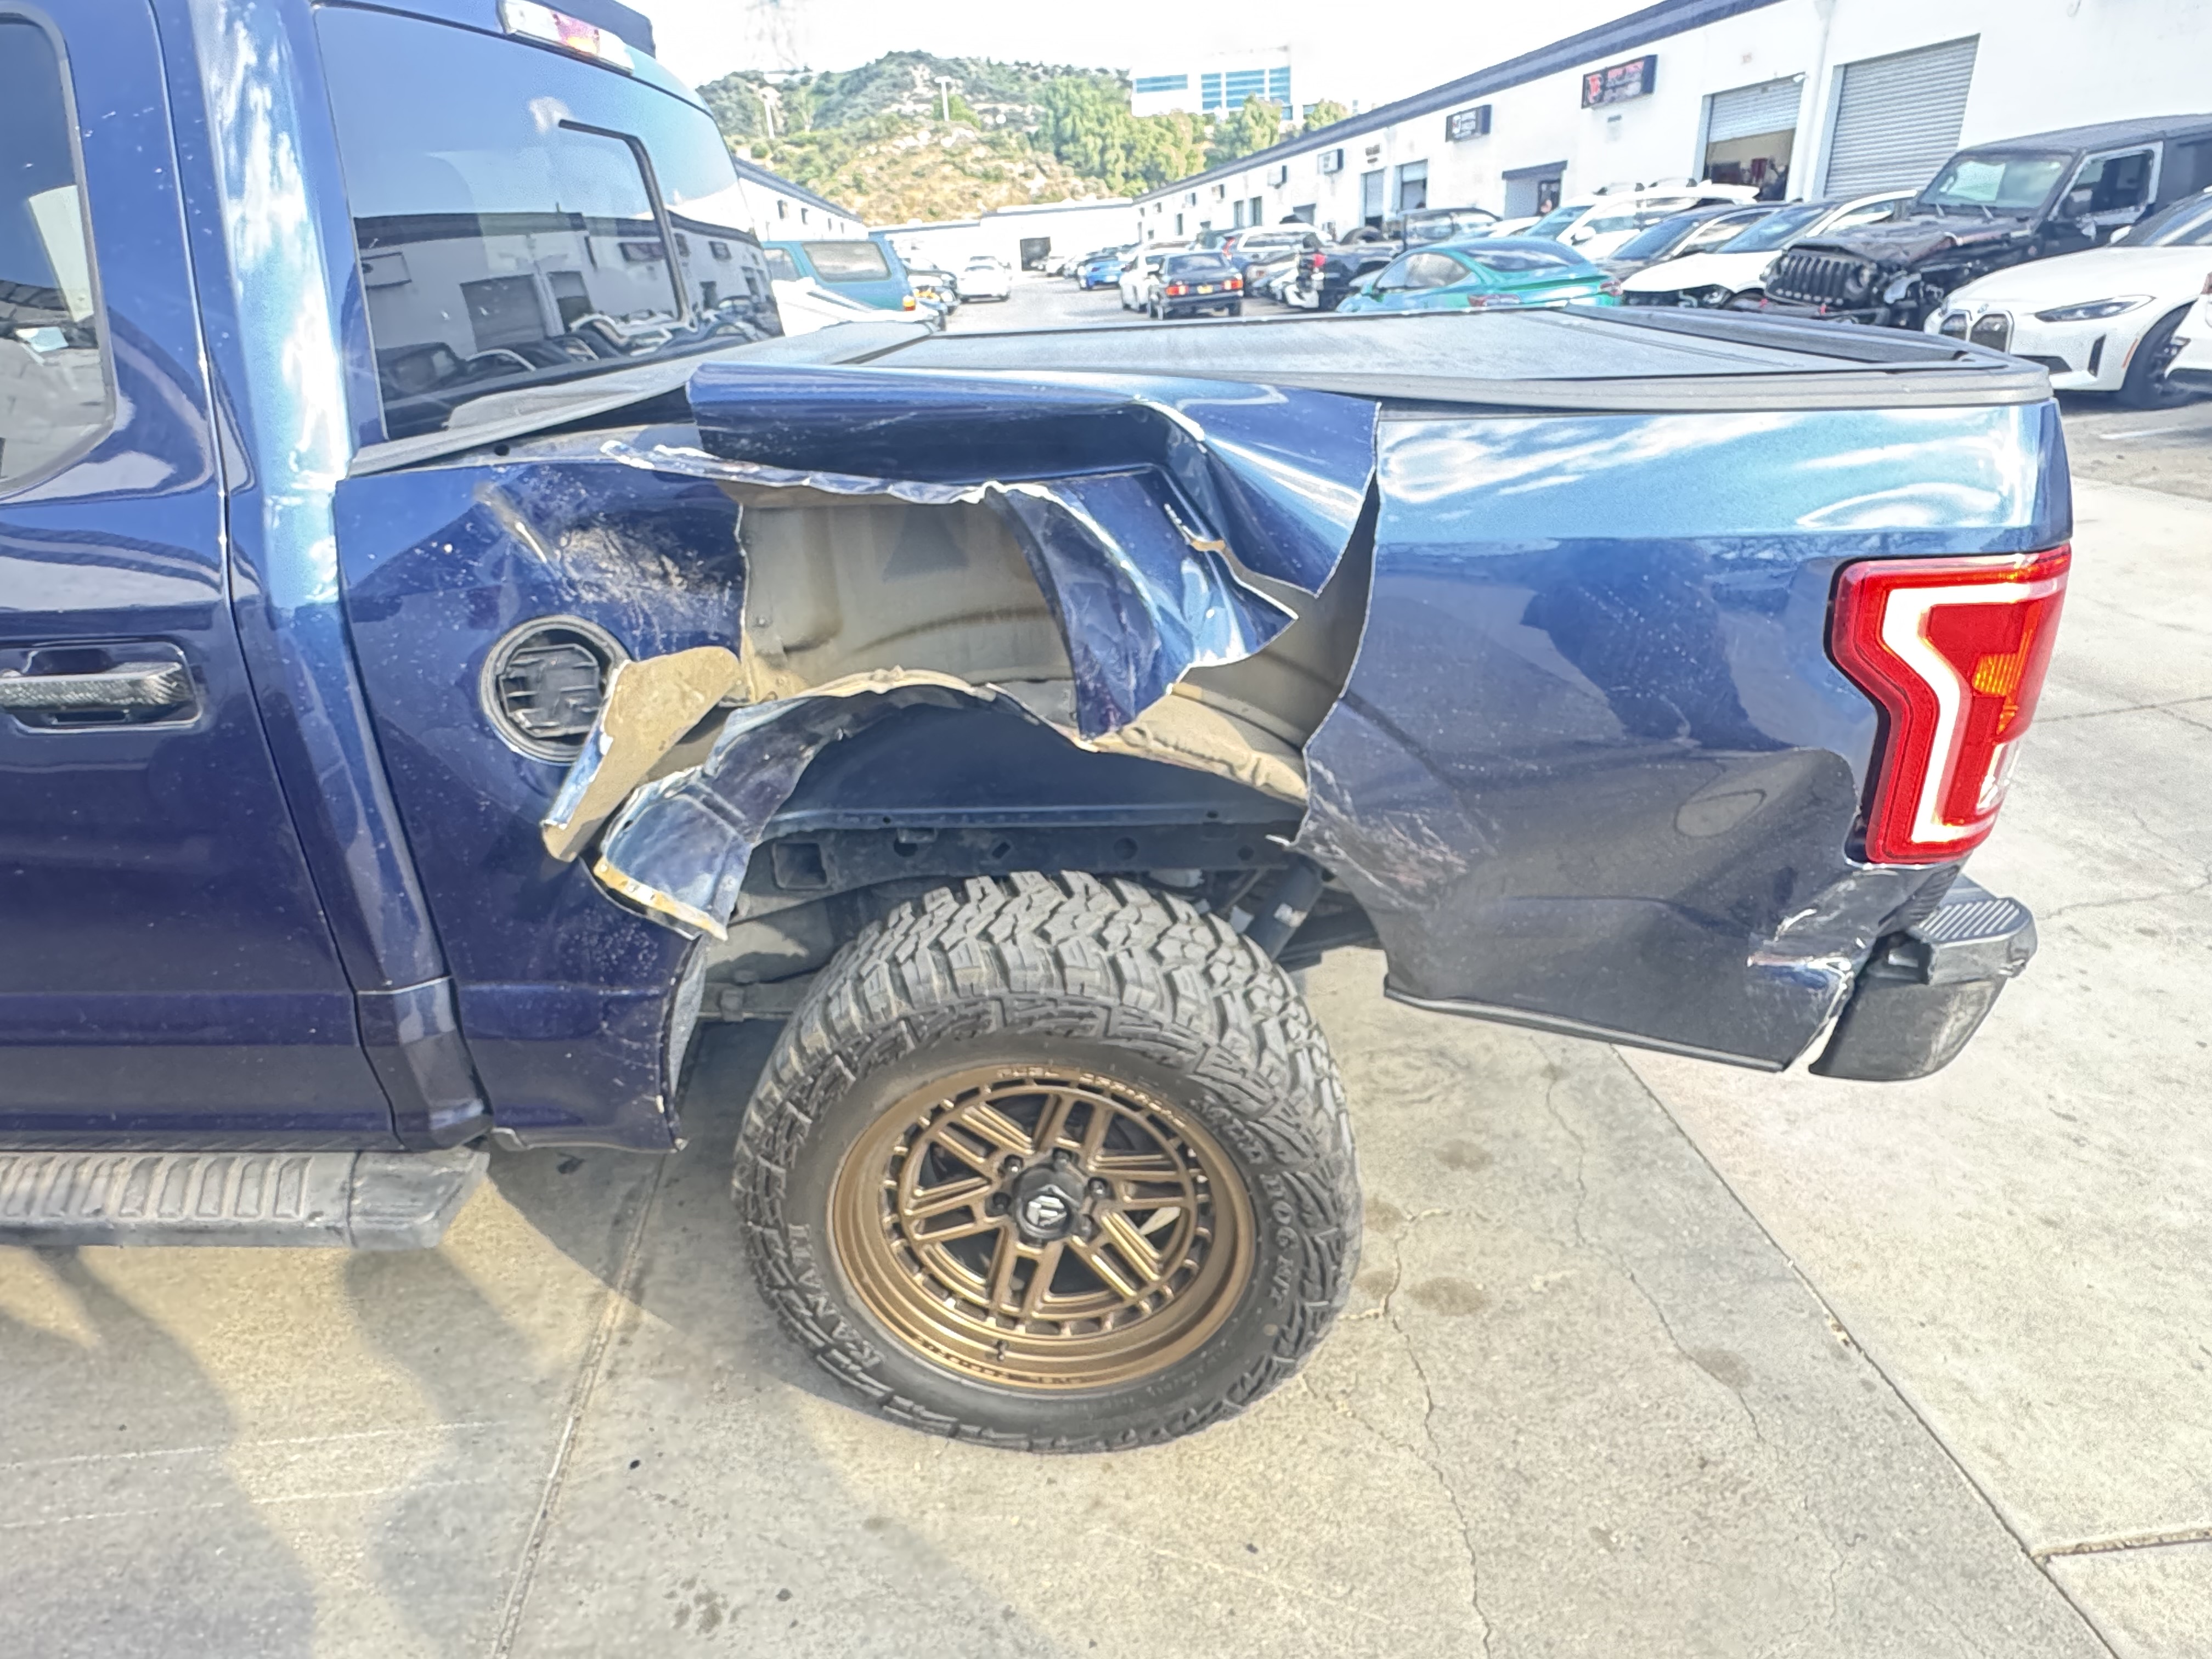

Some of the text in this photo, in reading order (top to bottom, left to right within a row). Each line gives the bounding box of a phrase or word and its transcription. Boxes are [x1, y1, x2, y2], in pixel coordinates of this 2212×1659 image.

[1189, 1094, 1268, 1165] MUD
[1259, 1173, 1299, 1249] HOG
[787, 1223, 887, 1368] KANATI
